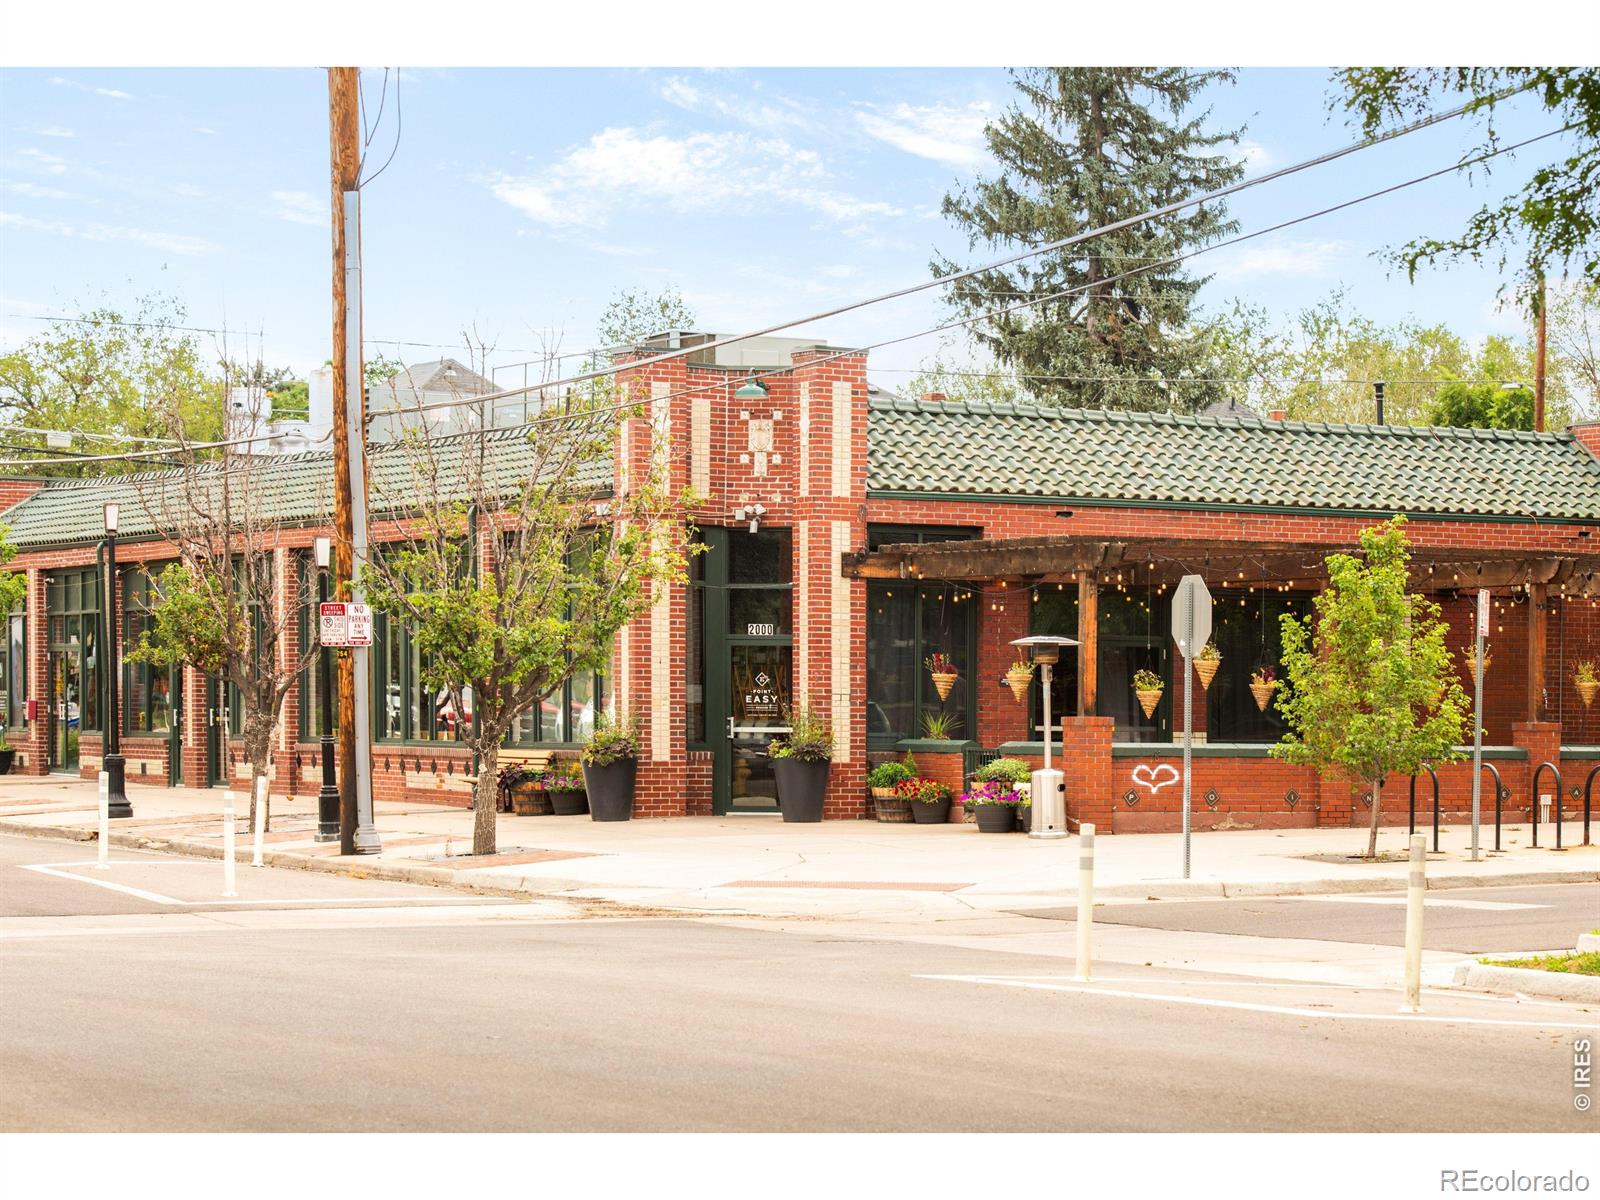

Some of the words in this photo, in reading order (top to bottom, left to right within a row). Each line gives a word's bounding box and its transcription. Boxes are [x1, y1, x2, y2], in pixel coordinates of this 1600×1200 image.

[354, 605, 364, 614] NO
[349, 615, 370, 623] PARKING
[748, 624, 773, 635] 2000
[745, 695, 778, 703] EASY
